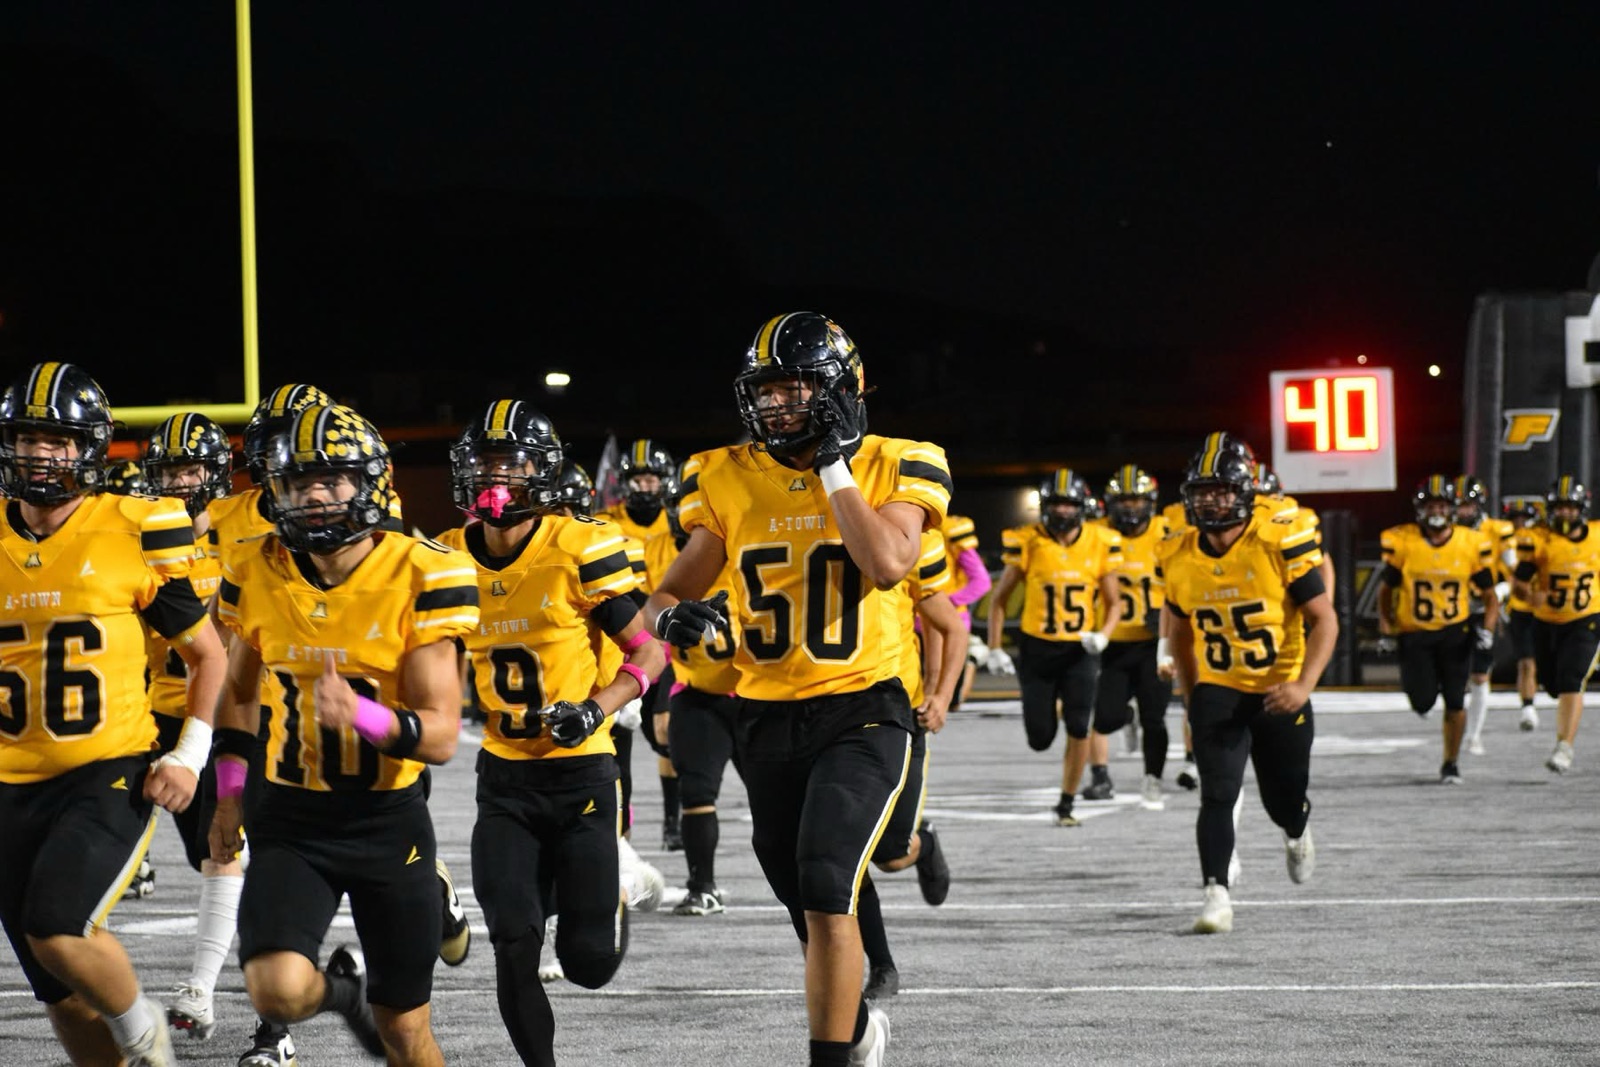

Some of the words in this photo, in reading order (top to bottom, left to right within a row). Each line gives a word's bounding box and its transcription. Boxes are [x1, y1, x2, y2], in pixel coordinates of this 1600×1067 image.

[1284, 375, 1379, 452] 40
[768, 514, 827, 533] A-TOWN
[4, 590, 62, 611] A-TOWN
[480, 617, 530, 636] A-TOWN
[738, 539, 867, 665] 50
[1042, 582, 1087, 635] 15
[1412, 580, 1461, 623] 63
[1193, 598, 1279, 674] 65
[486, 642, 548, 741] 9
